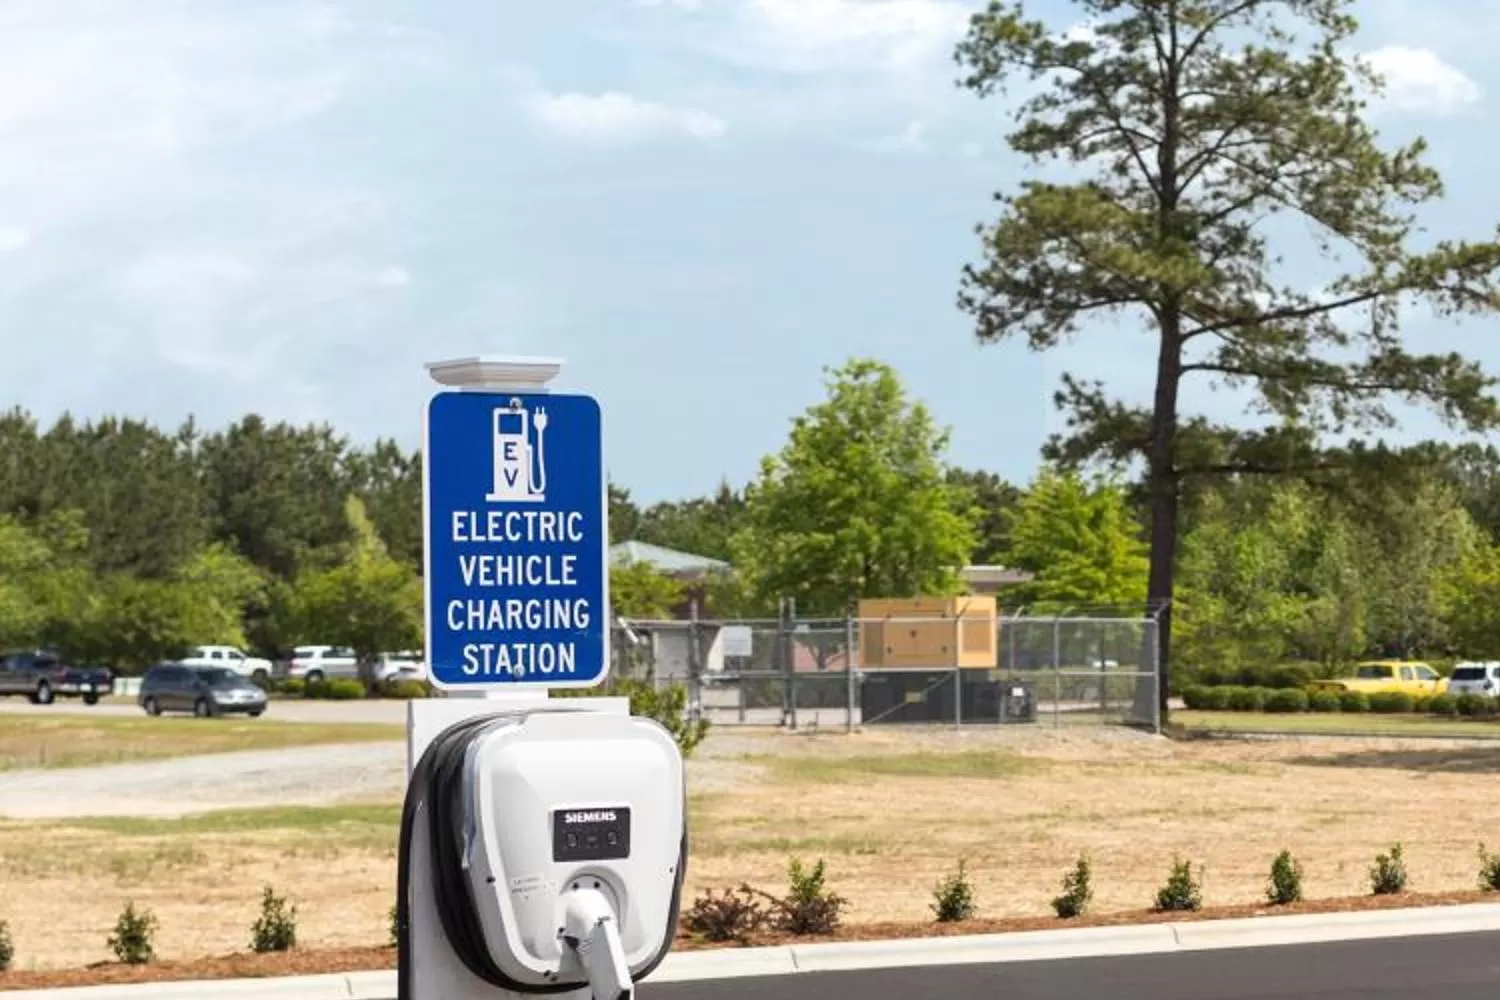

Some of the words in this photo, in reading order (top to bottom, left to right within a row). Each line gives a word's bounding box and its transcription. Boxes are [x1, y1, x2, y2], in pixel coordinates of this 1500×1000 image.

[452, 511, 583, 542] ELECTRIC
[459, 555, 577, 586] VEHICLE
[447, 598, 590, 631] CHARGING
[462, 642, 575, 675] STATION
